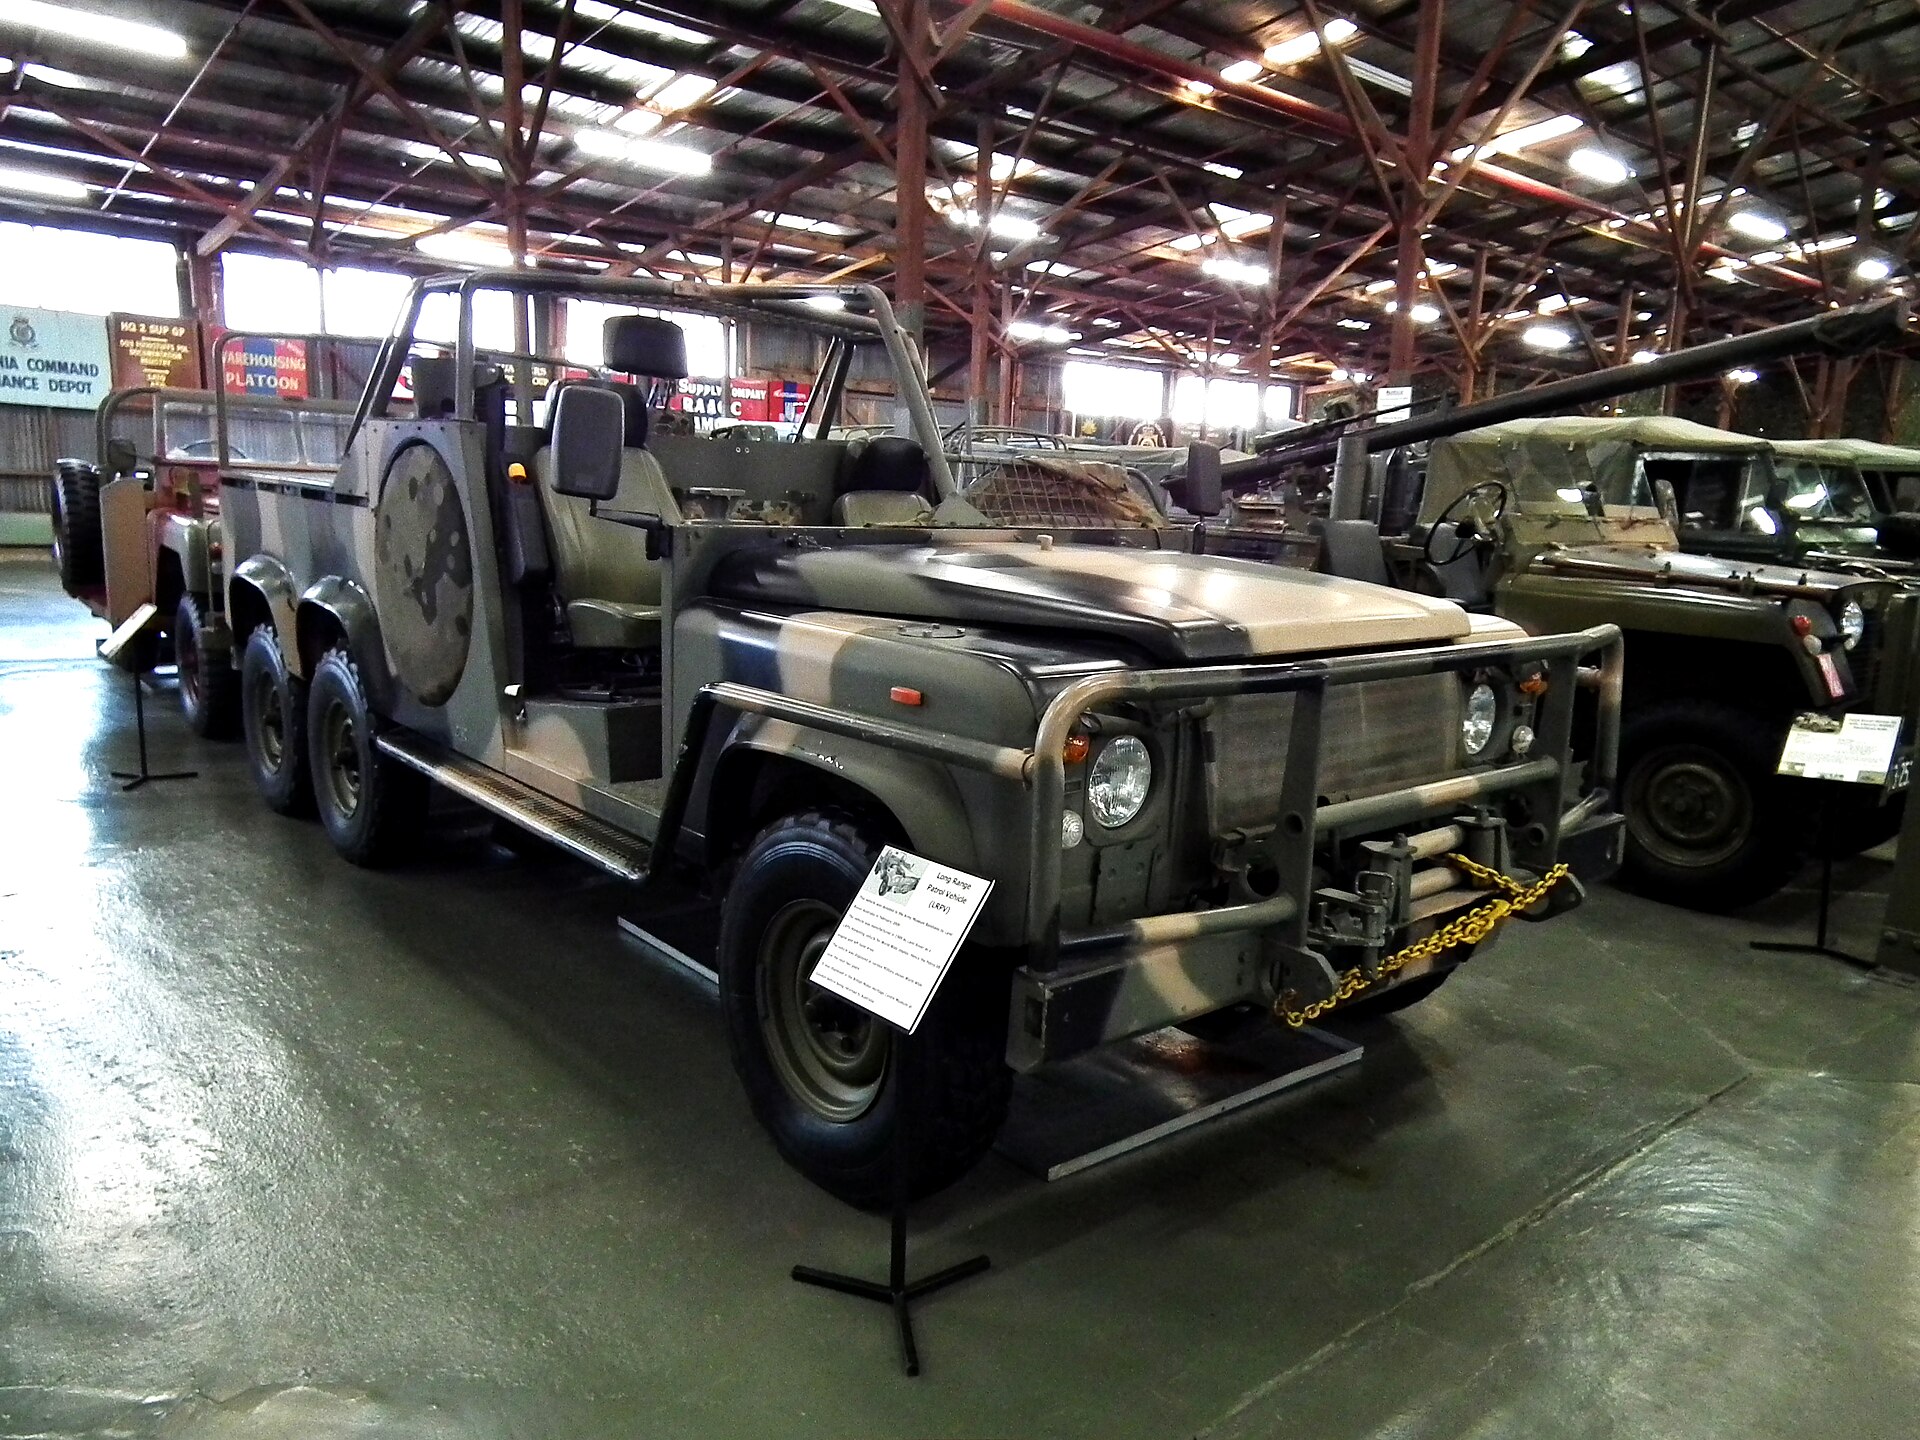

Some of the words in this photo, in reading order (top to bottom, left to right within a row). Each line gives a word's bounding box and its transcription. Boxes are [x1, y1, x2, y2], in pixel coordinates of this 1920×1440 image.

[139, 323, 147, 333] 2
[27, 358, 99, 377] COMMAND
[0, 374, 40, 390] ANCE
[48, 379, 92, 394] DEPOT
[225, 371, 299, 390] PLATOON
[730, 386, 767, 400] OMPANY
[936, 872, 952, 884] Long
[952, 878, 972, 890] Range
[926, 883, 946, 895] Patrol
[946, 890, 967, 904] Vehicle
